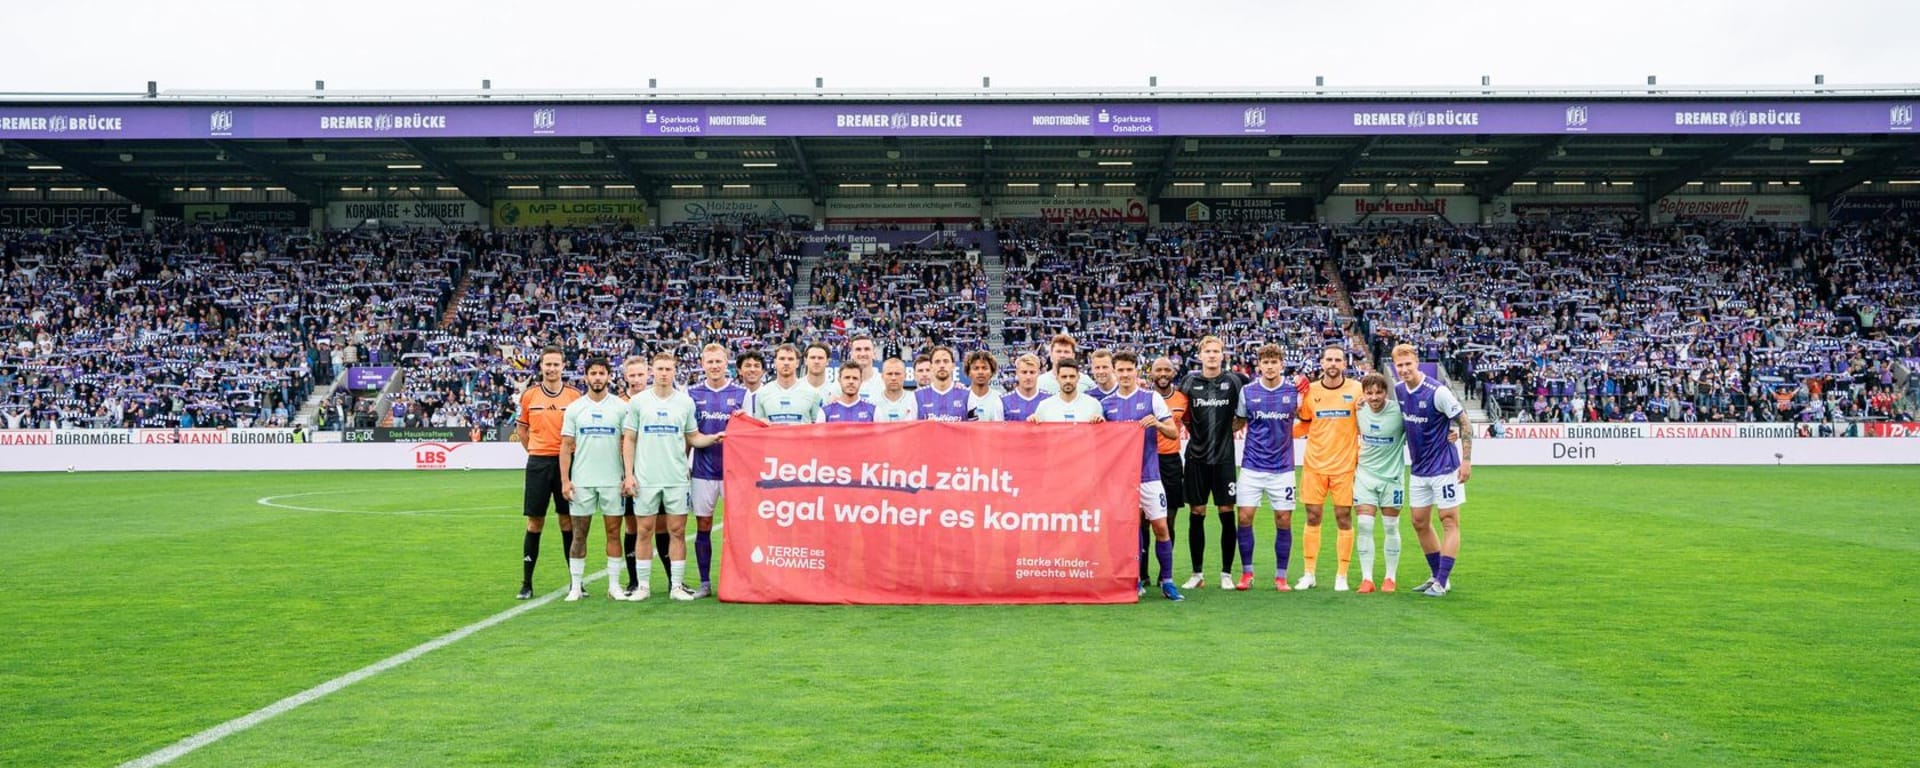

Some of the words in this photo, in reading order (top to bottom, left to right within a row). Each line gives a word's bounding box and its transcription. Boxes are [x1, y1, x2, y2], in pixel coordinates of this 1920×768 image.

[69, 114, 122, 130] BRÜCKE
[320, 116, 373, 129] BREMER
[394, 113, 446, 129] BRÜCKE
[660, 115, 699, 125] Sparkasse
[709, 114, 767, 126] NORDTRIBÜNE
[837, 115, 889, 128] BREMER
[910, 112, 963, 128] BRÜCKE
[1032, 113, 1090, 126] NORDTRIBÜNE
[1112, 115, 1151, 124] Sparkasse
[1353, 113, 1405, 126] BREMER
[1427, 109, 1479, 126] BRÜCKE
[1675, 112, 1728, 125] BREMER
[1749, 108, 1801, 125] BRÜCKE
[660, 125, 701, 133] Osnabrück
[1112, 124, 1153, 133] Osnabrück
[414, 203, 466, 218] SCHUBERT
[529, 203, 557, 213] MP
[562, 203, 642, 213] LOGISTIK
[1040, 208, 1123, 218] WIEMANN
[1659, 197, 1749, 219] Behrenswerth
[847, 234, 877, 243] Beton
[404, 430, 454, 438] Hauskraftwerk
[1484, 427, 1560, 438] ASMANN
[1568, 424, 1644, 438] BÜROMÖBEL
[1657, 427, 1732, 438] ASSMANN
[55, 432, 133, 444] BÜROMÖBEL
[145, 433, 223, 444] ASSMANN
[231, 432, 293, 444] BÜROMÖB
[1552, 442, 1596, 459] Dein
[416, 451, 446, 463] LBS
[759, 457, 852, 485] Jedes
[861, 462, 928, 489] Kind
[935, 465, 1020, 497] zählt,
[1442, 483, 1456, 499] 15
[1159, 493, 1166, 507] 8
[757, 495, 825, 527] egal
[834, 499, 932, 527] woher
[939, 508, 975, 529] es
[983, 504, 1101, 533] kommt!
[767, 545, 809, 557] TERRE
[810, 549, 825, 557] DES
[765, 557, 825, 570] HOMMES
[1016, 557, 1052, 567] starke
[1054, 557, 1090, 568] Kinder
[1015, 568, 1066, 579] gerechte
[1069, 568, 1094, 578] Welt
